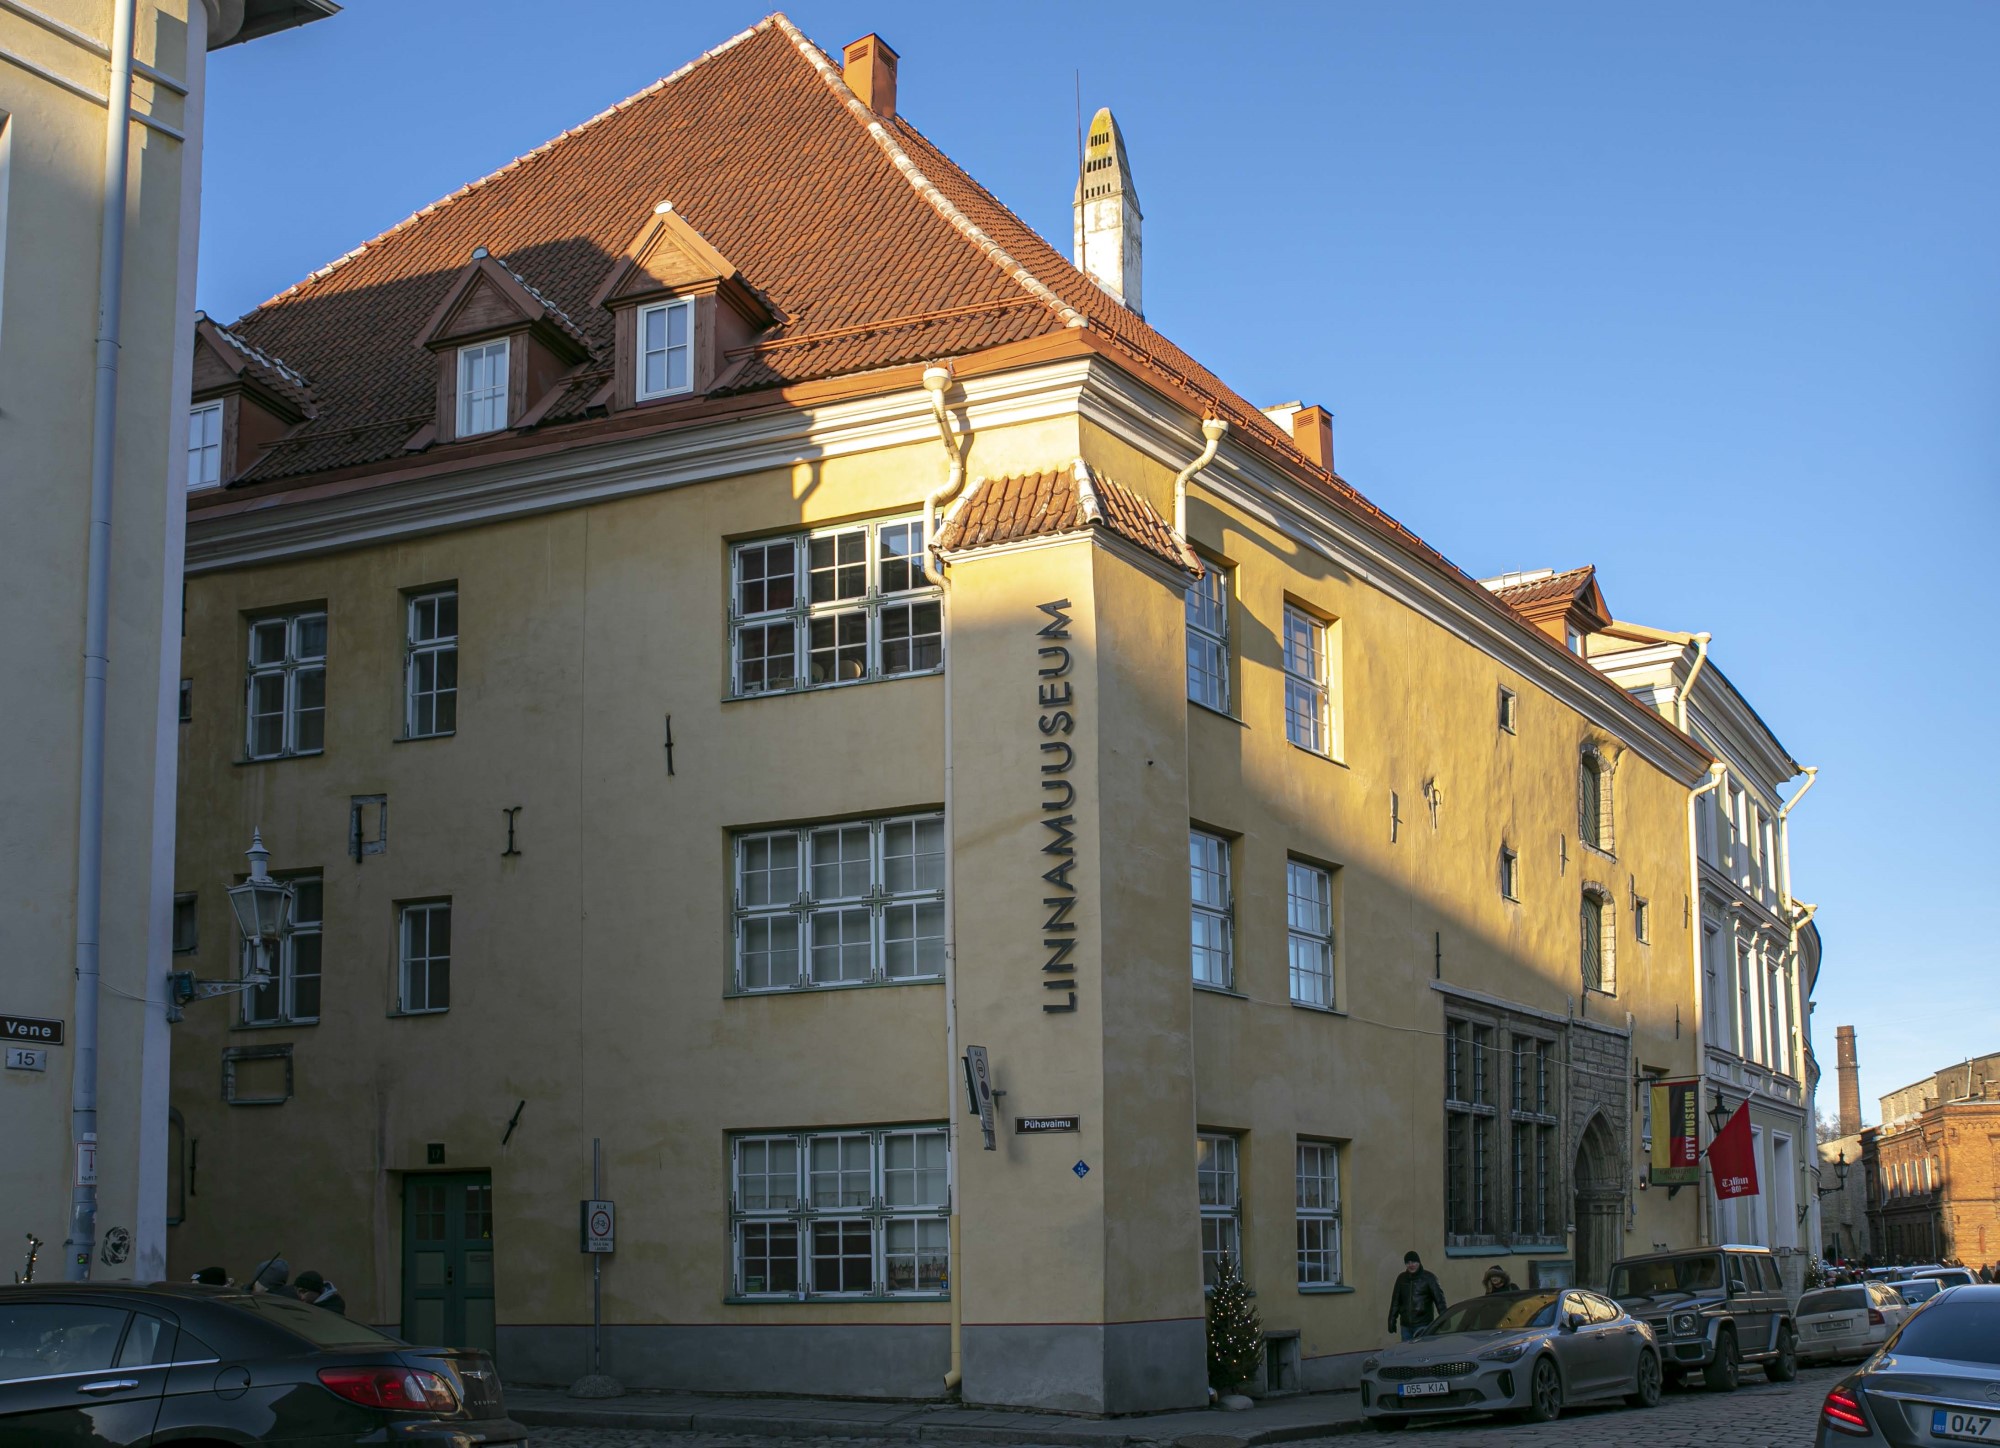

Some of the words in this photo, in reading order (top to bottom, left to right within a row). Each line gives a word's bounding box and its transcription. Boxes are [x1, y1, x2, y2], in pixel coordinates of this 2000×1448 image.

[1036, 598, 1077, 1013] LINNAMUUSEUM
[6, 1021, 52, 1037] Vene
[16, 1052, 35, 1066] 15
[1024, 1119, 1071, 1129] Pühavaimu
[1684, 1091, 1696, 1160] CITYMUSEUM
[1721, 1176, 1749, 1188] Tallinn
[1428, 1383, 1445, 1393] KIA
[1952, 1414, 1991, 1435] 047
